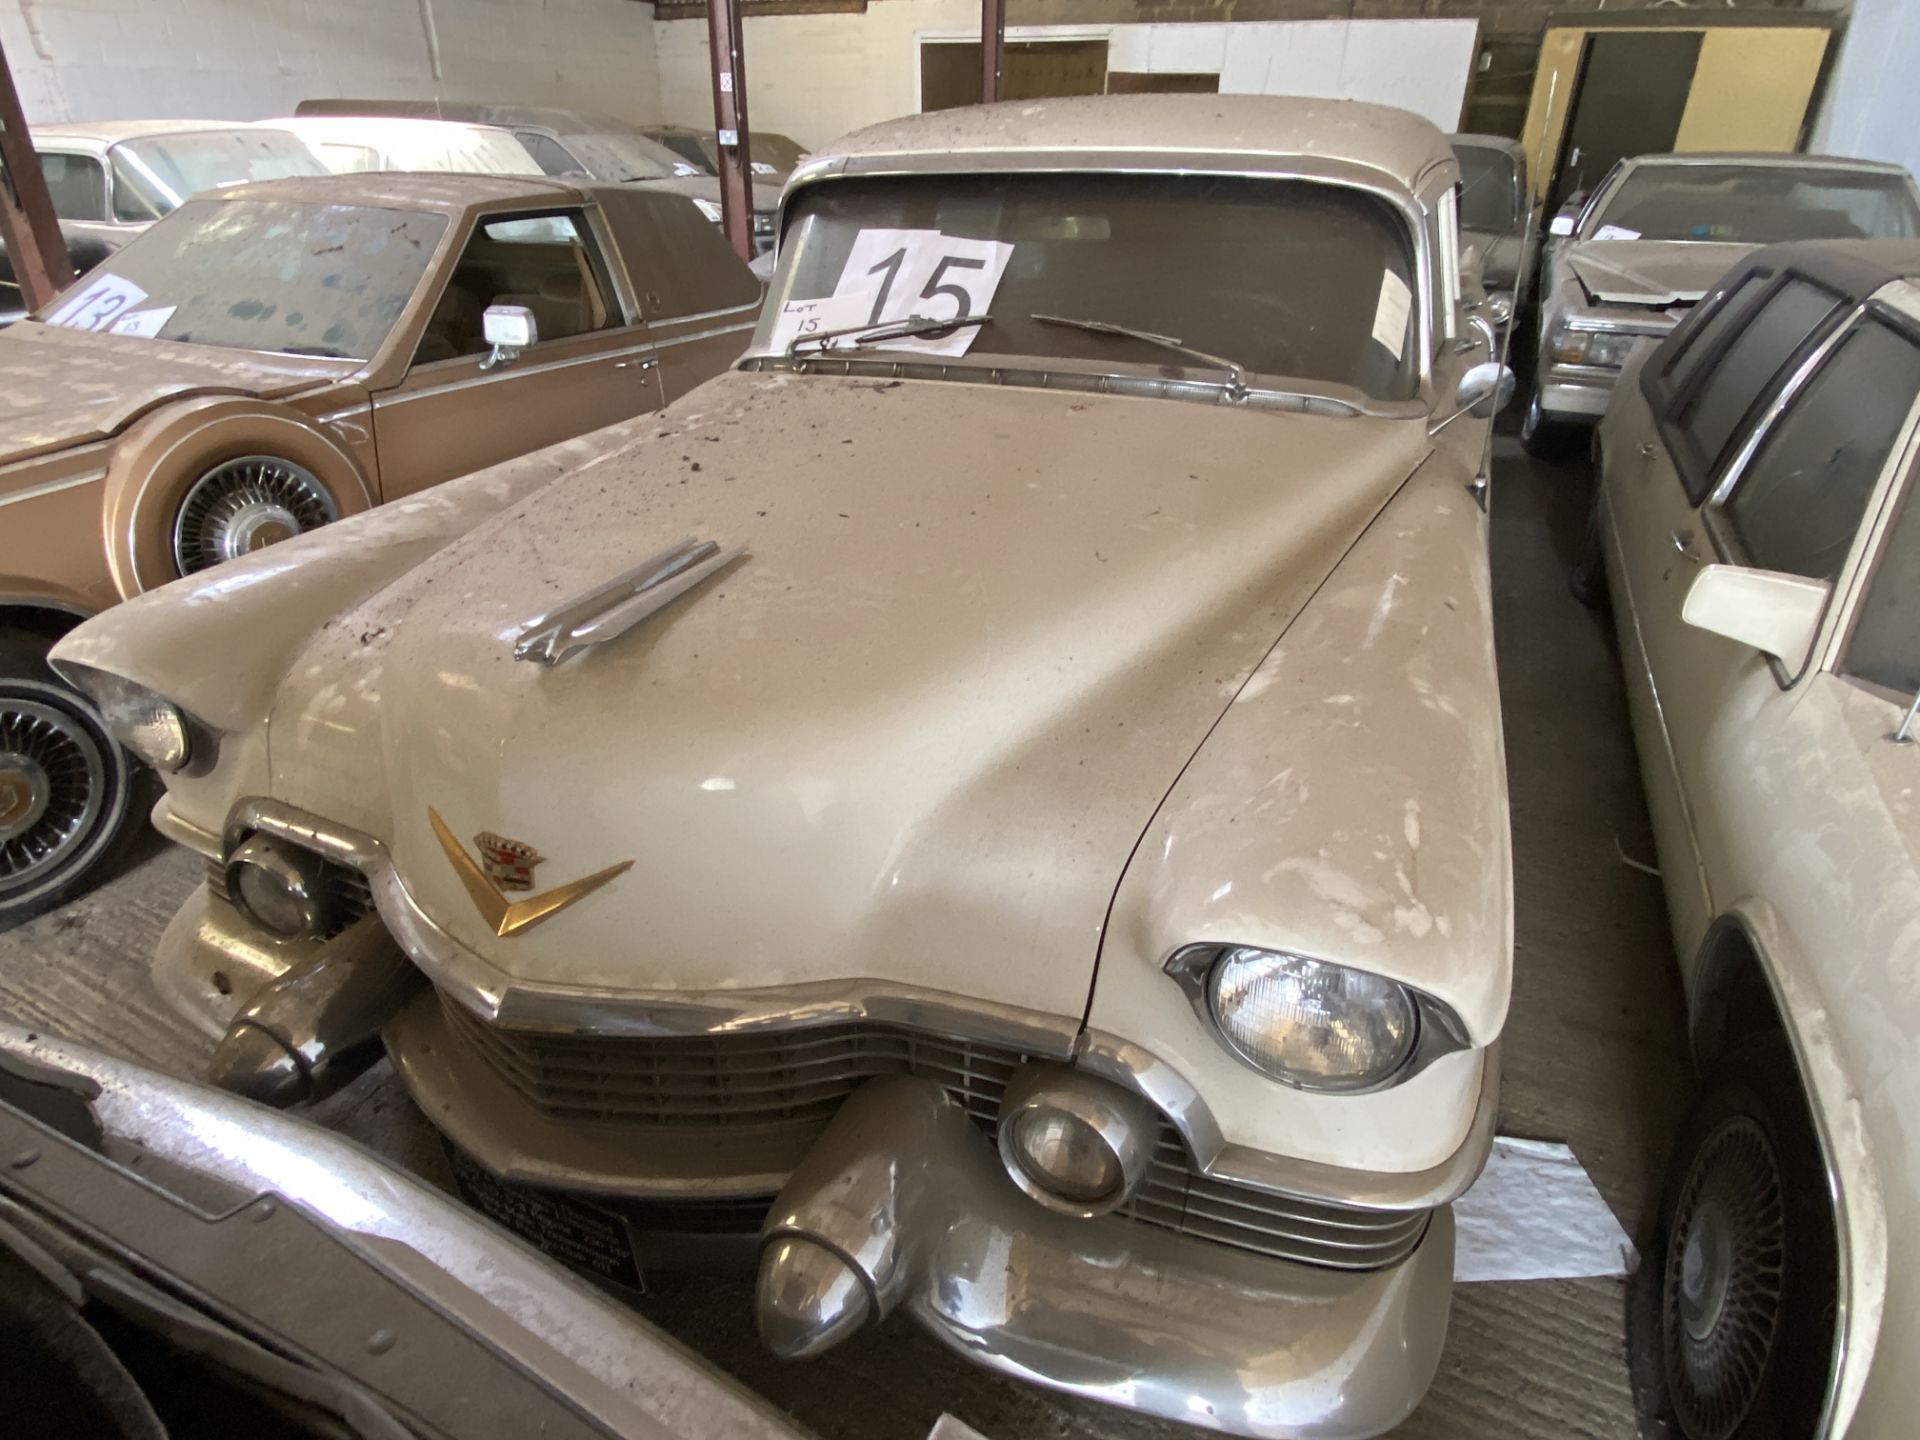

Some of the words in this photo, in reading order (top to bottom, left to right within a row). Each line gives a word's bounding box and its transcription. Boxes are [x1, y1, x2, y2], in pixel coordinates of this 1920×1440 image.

[60, 287, 127, 331] 13
[867, 248, 986, 340] 15
[798, 317, 821, 332] 15
